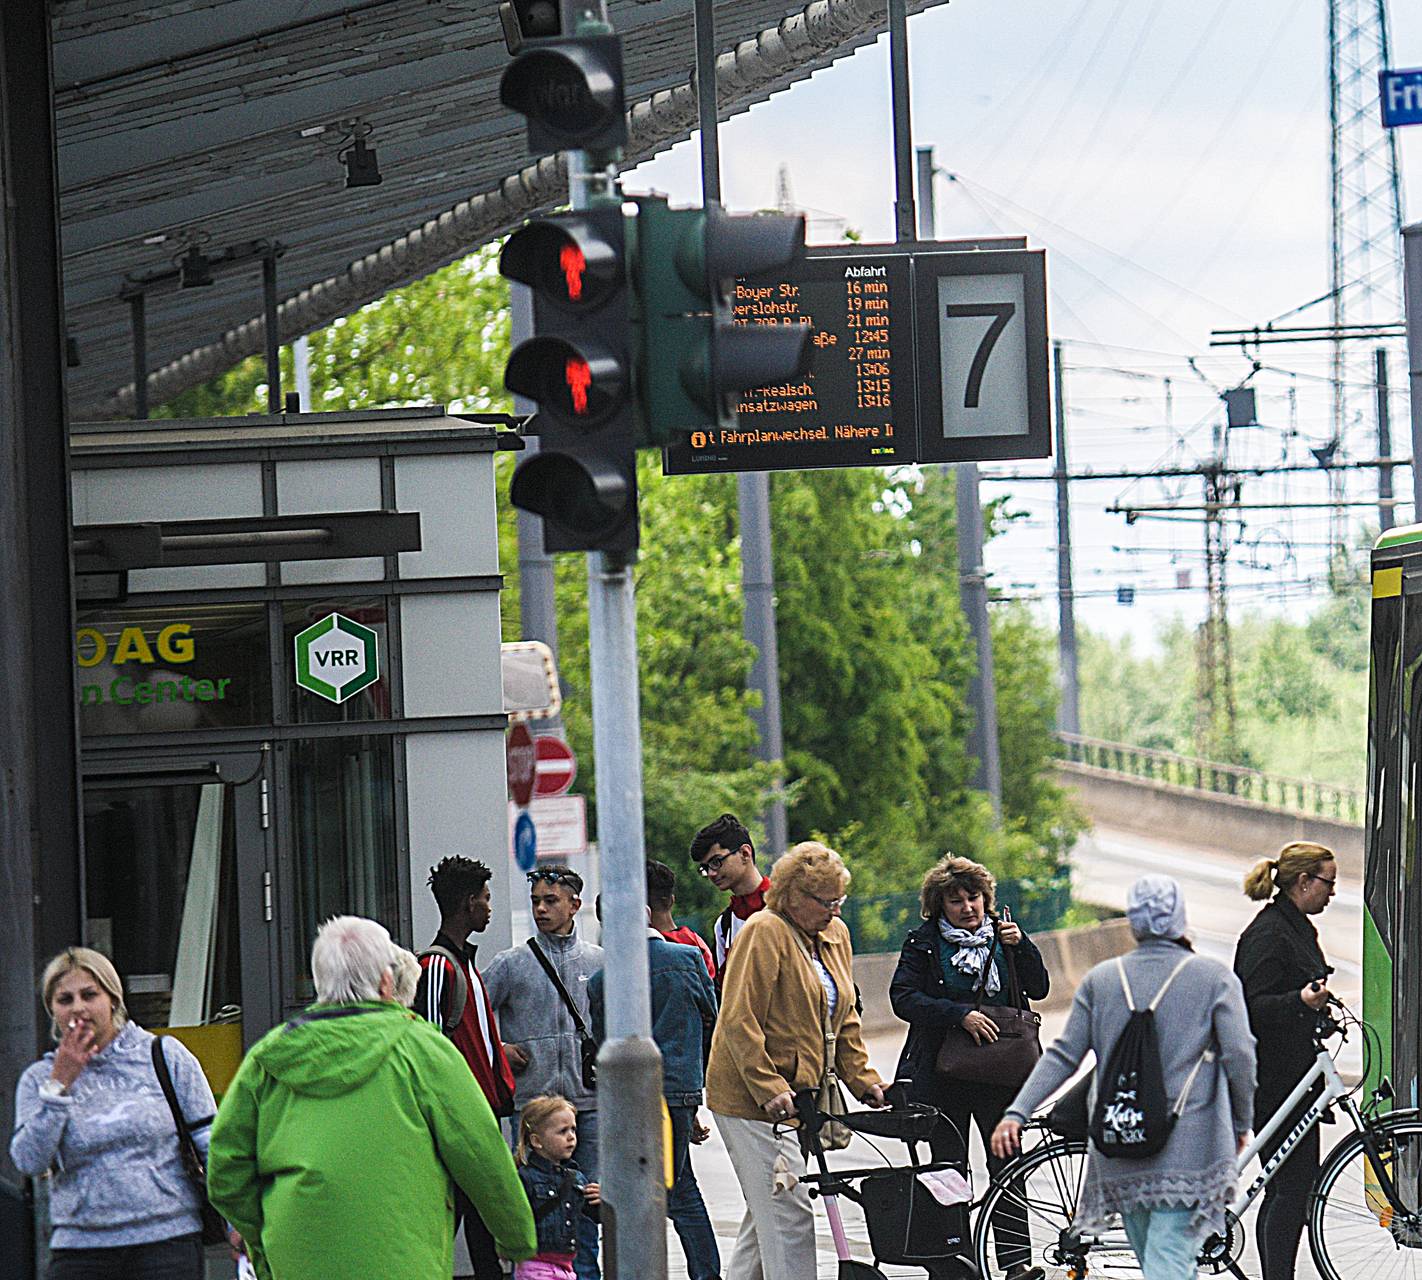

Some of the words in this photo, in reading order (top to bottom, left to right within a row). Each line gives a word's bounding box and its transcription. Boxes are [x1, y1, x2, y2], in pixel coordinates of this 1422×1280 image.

[845, 266, 887, 278] Abfahrt
[779, 283, 800, 297] Str.
[847, 281, 861, 294] 16
[864, 280, 888, 293] min
[848, 297, 862, 311] 19
[865, 297, 889, 310] min
[847, 314, 862, 327] 21
[865, 313, 889, 326] min
[855, 329, 889, 343] 12:45
[848, 347, 864, 360] 27
[867, 346, 890, 359] min
[945, 303, 1016, 409] 7
[856, 363, 890, 376] 13:06
[857, 378, 891, 392] 13:15
[857, 394, 891, 408] 13:16
[721, 426, 829, 445] Fahrplanwechsel.
[834, 424, 880, 439] Nähere
[315, 648, 360, 668] VRR
[109, 674, 230, 706] Center
